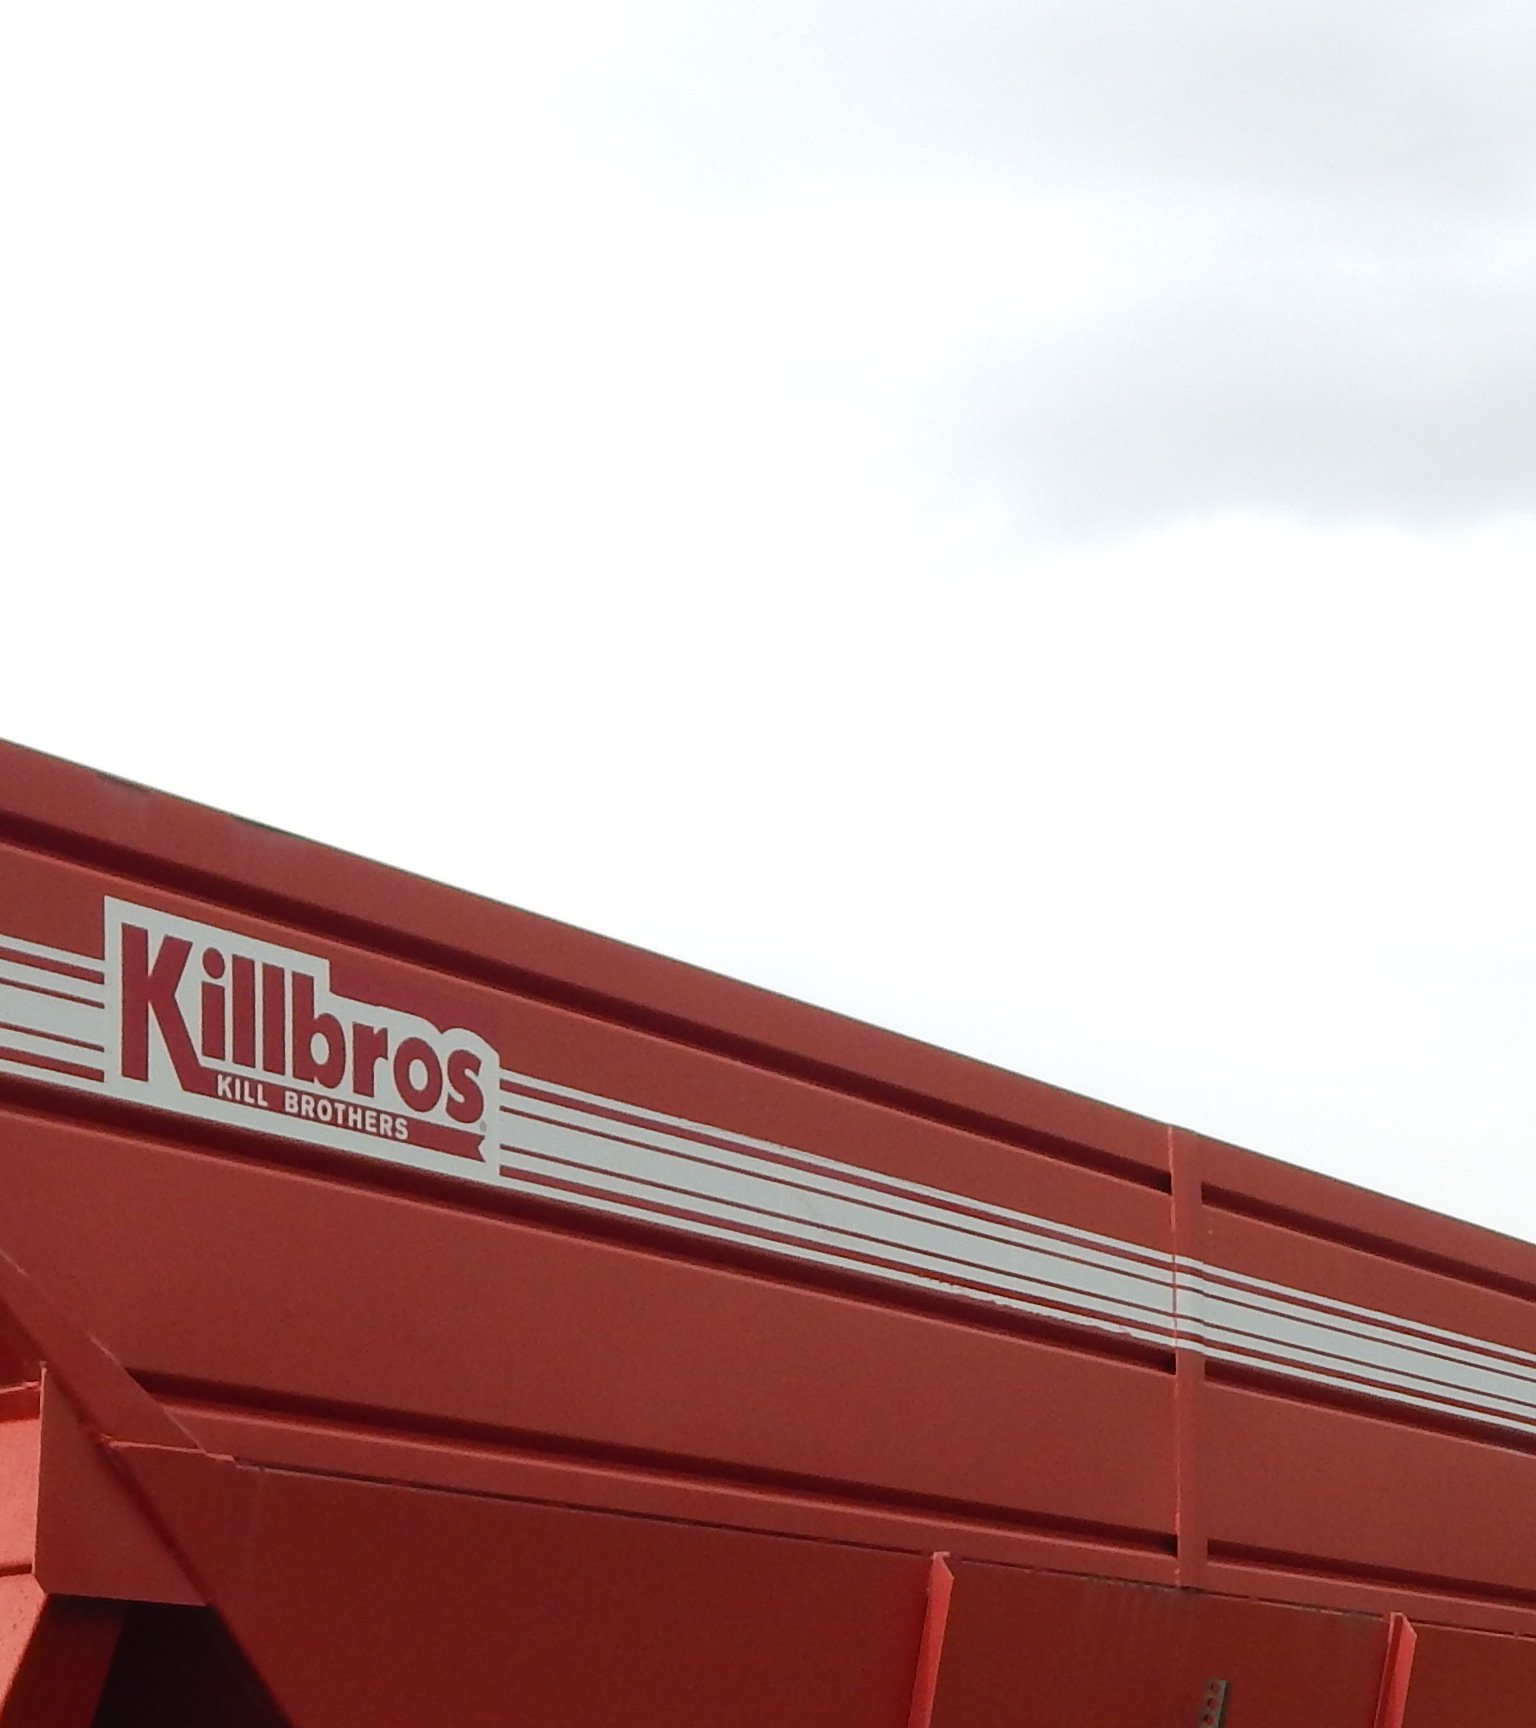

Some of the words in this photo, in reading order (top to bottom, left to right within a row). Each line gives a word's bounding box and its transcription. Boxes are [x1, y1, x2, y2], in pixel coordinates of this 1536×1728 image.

[121, 922, 484, 1124] Killbros
[217, 1074, 268, 1107] KILL
[285, 1091, 409, 1140] BROTHERS
